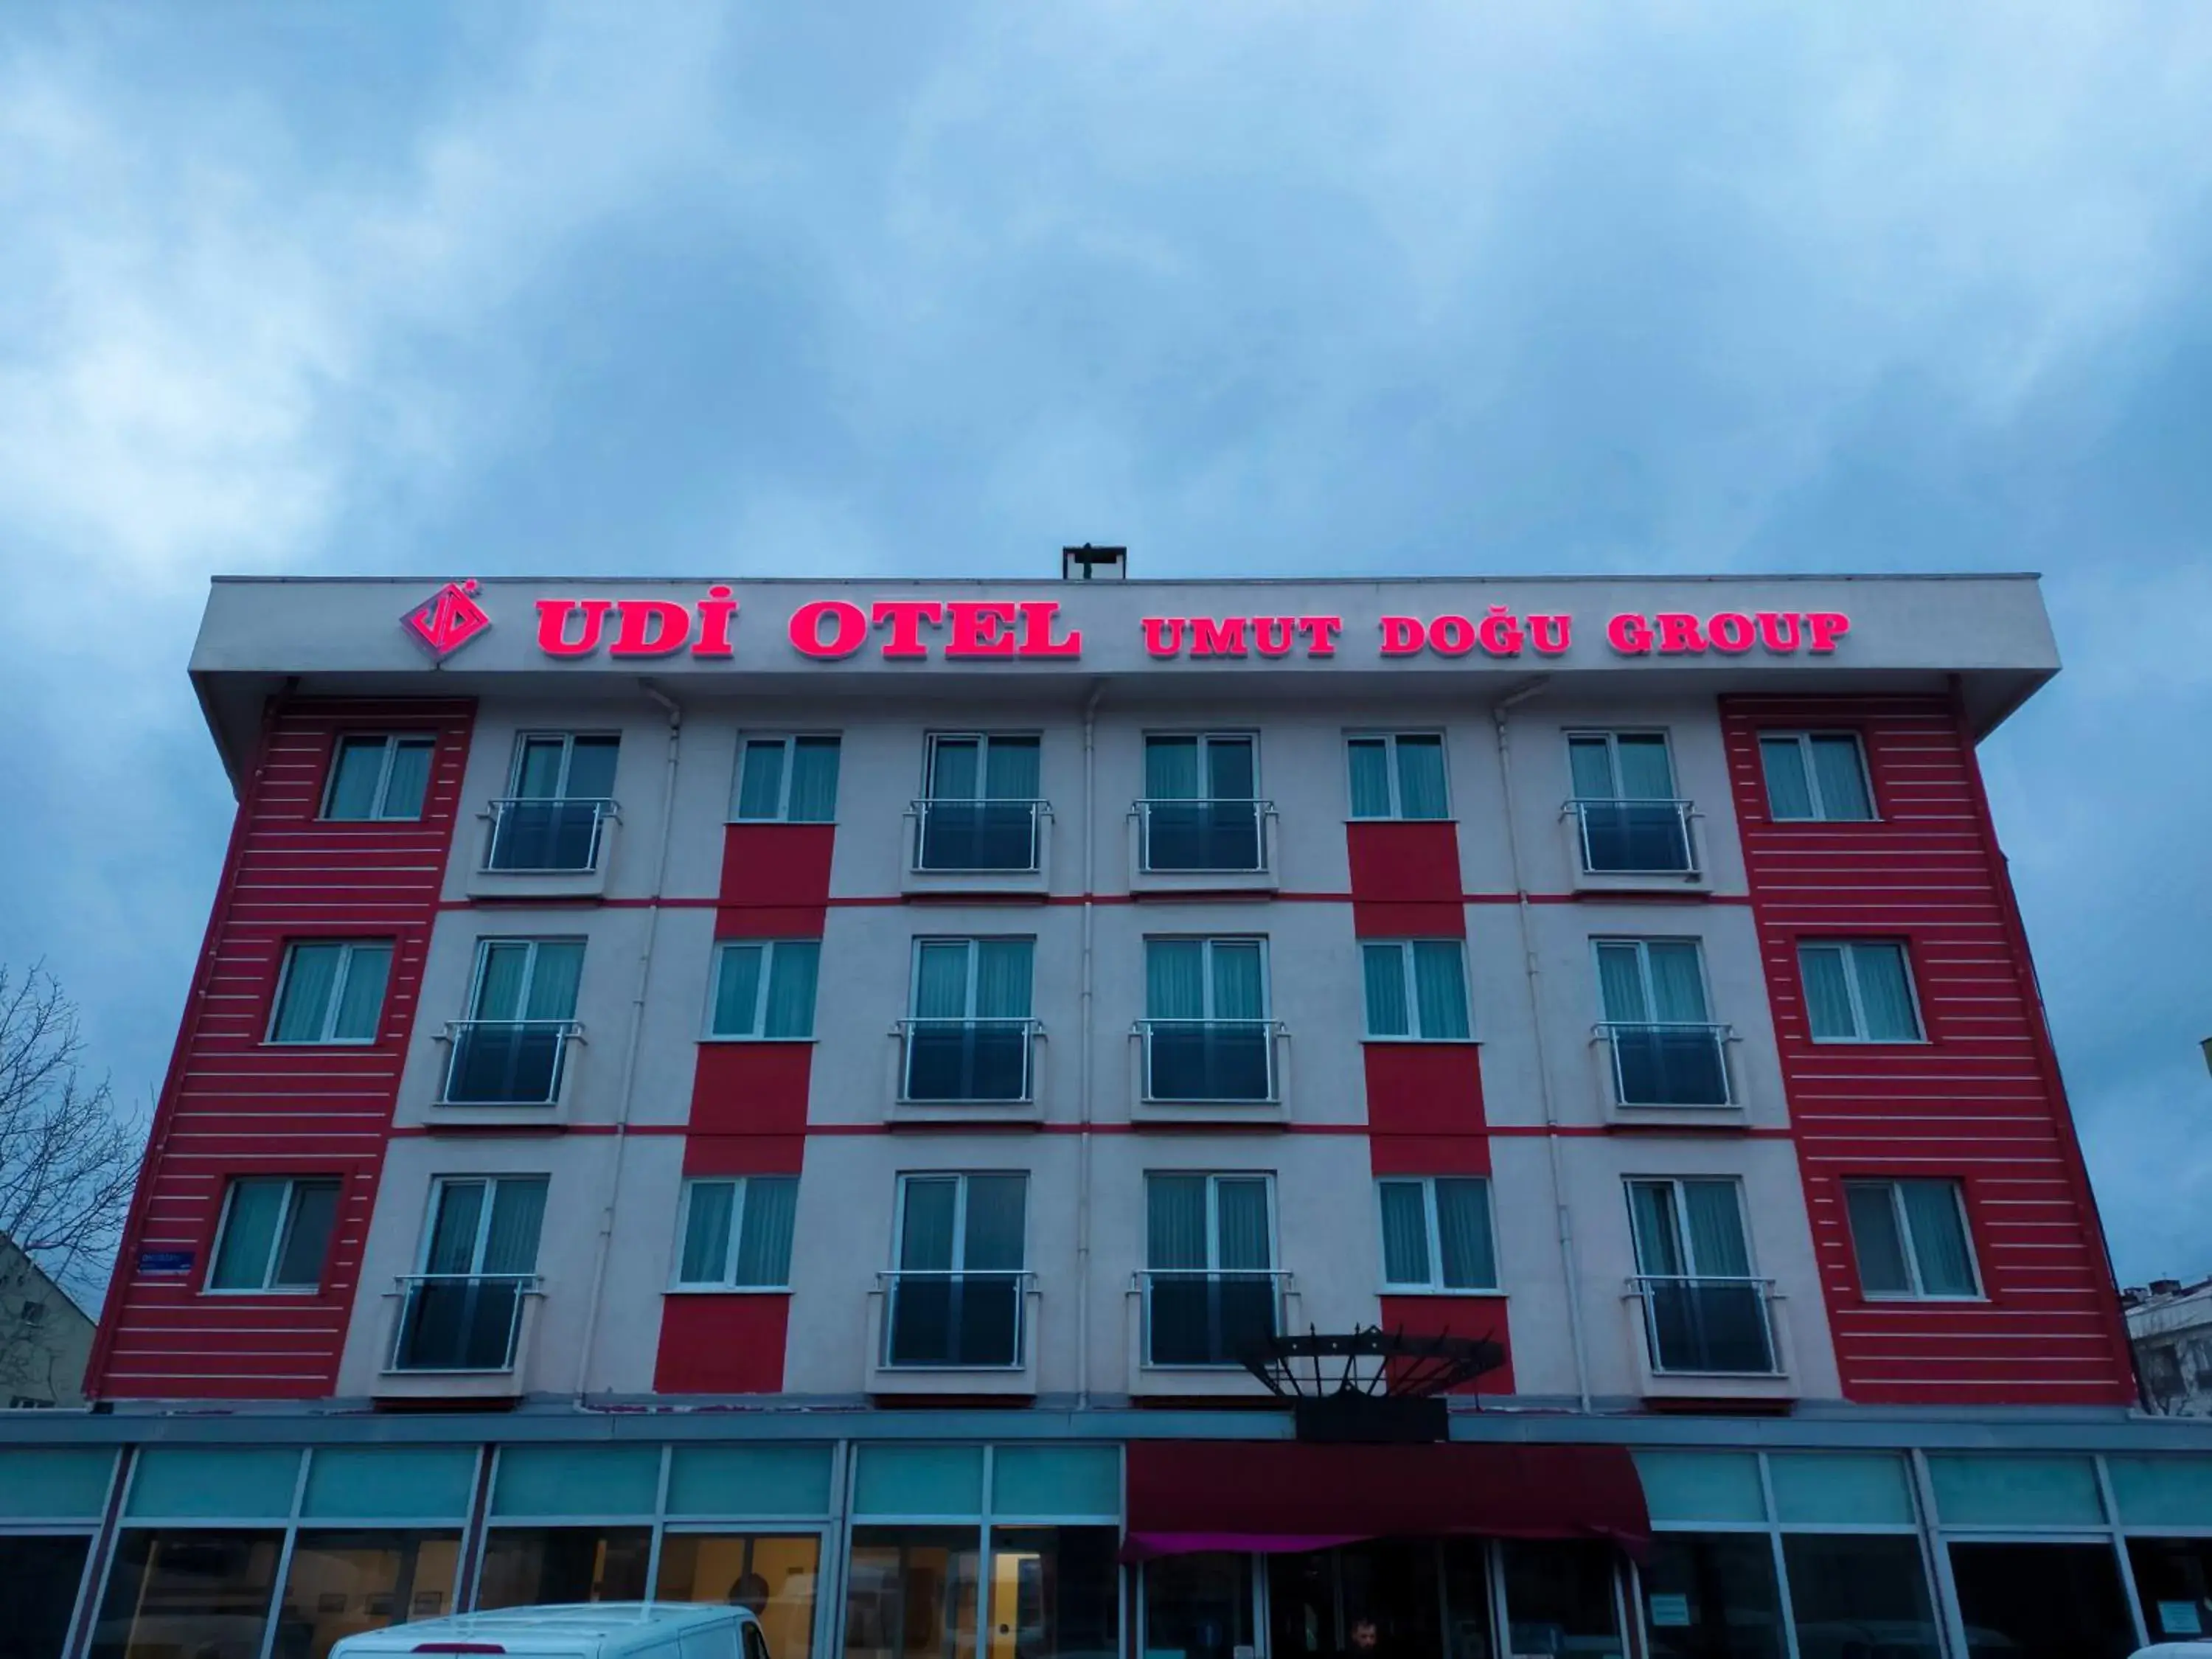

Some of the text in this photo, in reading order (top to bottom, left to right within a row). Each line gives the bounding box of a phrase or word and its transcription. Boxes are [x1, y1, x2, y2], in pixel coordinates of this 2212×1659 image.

[535, 585, 1850, 655] UDİ OTEL UMUT DOĞU GROUP
